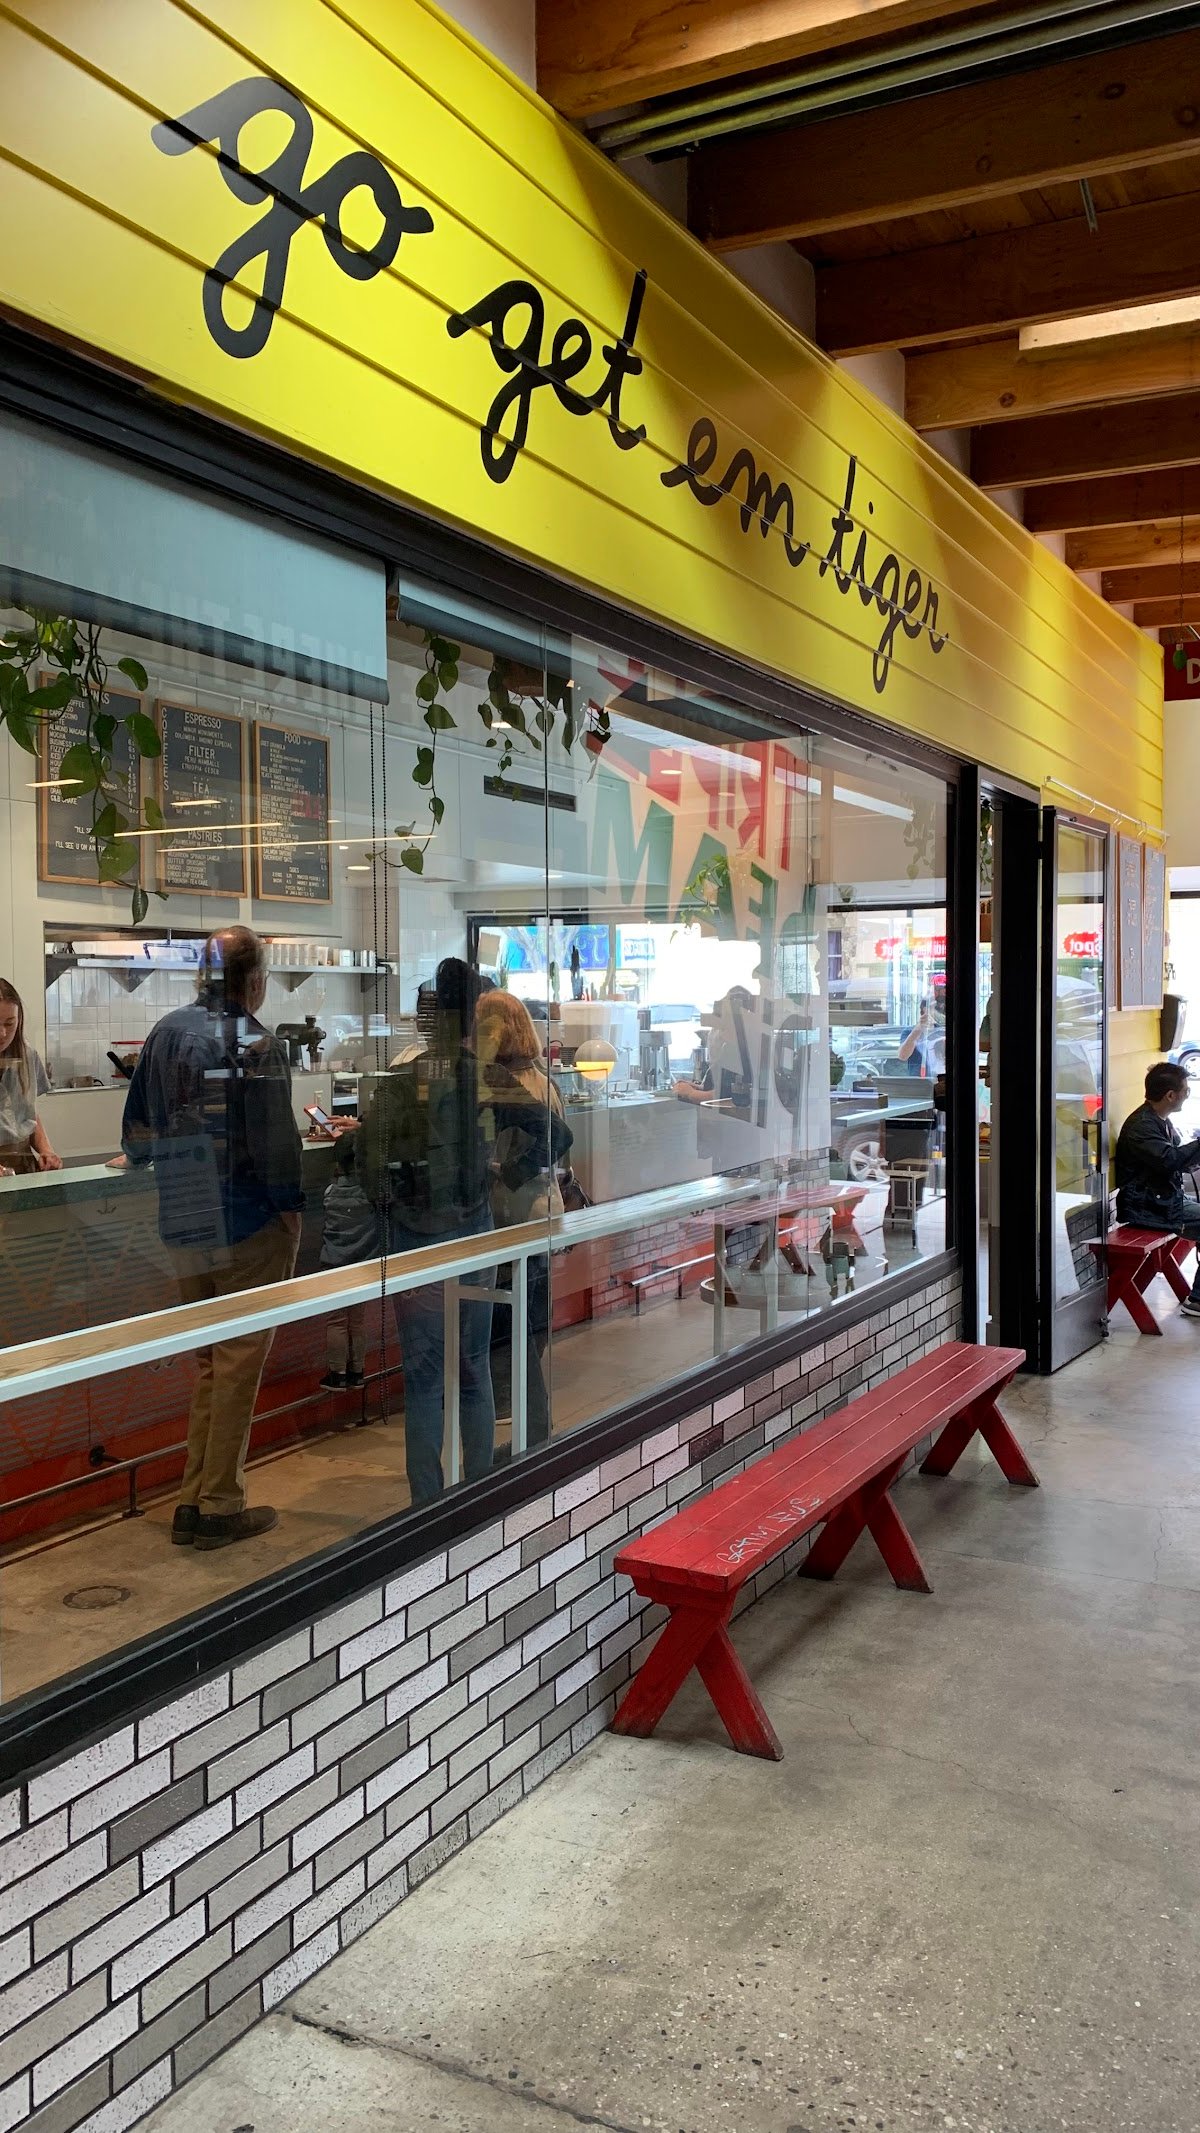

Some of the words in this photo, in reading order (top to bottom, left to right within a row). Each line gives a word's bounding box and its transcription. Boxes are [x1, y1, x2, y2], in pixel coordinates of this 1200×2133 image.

[151, 76, 434, 359] go
[446, 269, 647, 484] get
[660, 417, 810, 568] em
[818, 455, 949, 694] tiger
[184, 712, 222, 730] ESPRESSO
[284, 732, 301, 746] FOOD
[188, 744, 216, 761] FILTER
[192, 780, 211, 796] TEA
[187, 830, 223, 844] PASTRIES
